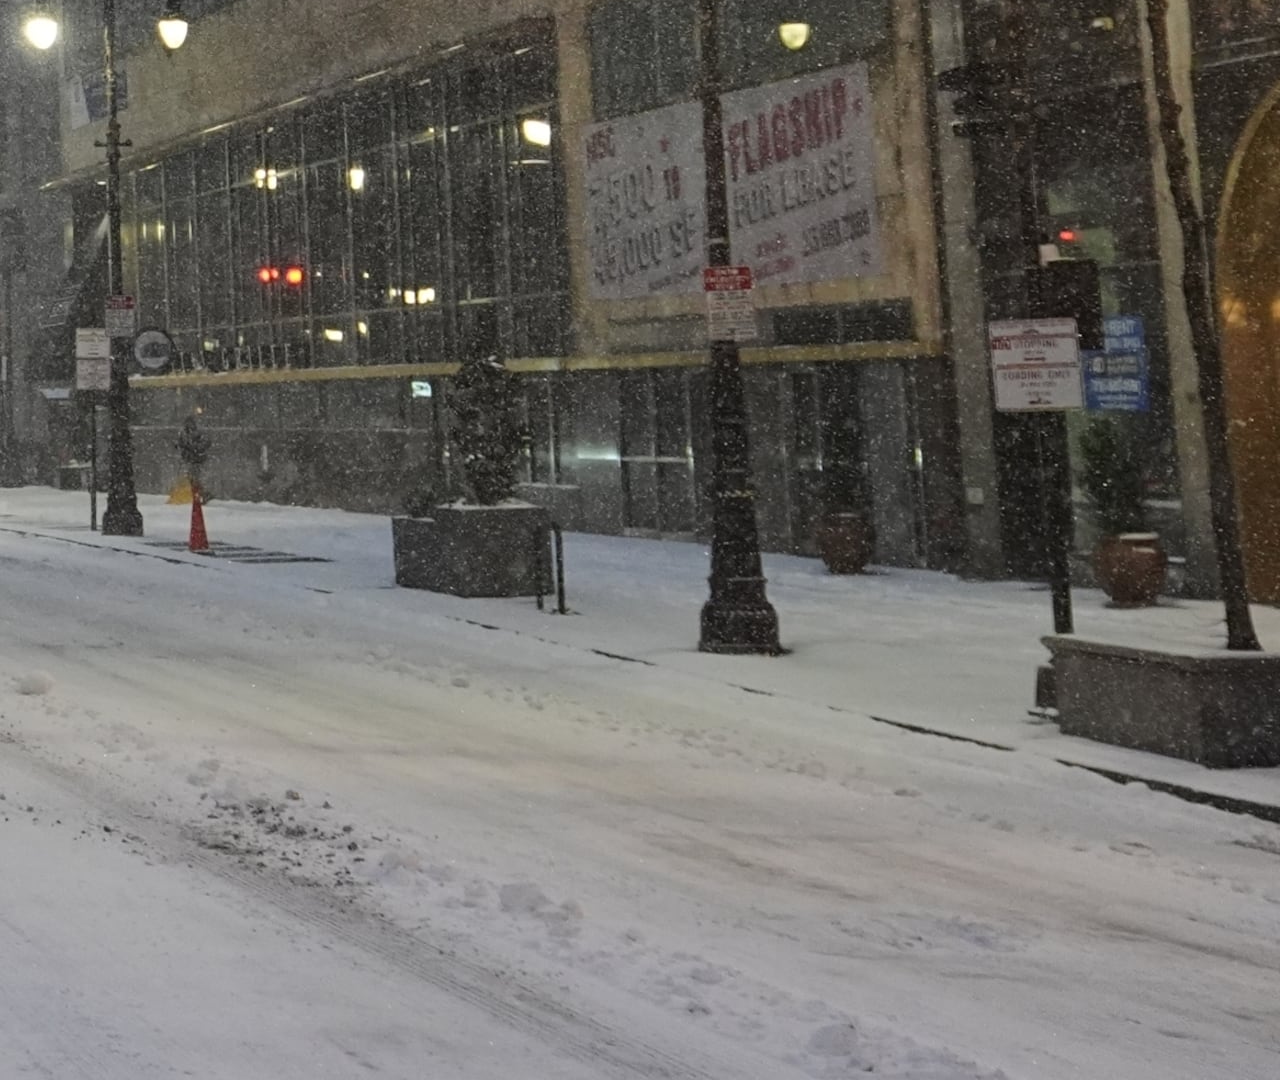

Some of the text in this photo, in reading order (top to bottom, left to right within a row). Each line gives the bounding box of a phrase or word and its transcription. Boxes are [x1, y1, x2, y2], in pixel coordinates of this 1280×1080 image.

[727, 77, 847, 183] FLAGSHIP
[733, 149, 857, 230] FOR LEASE
